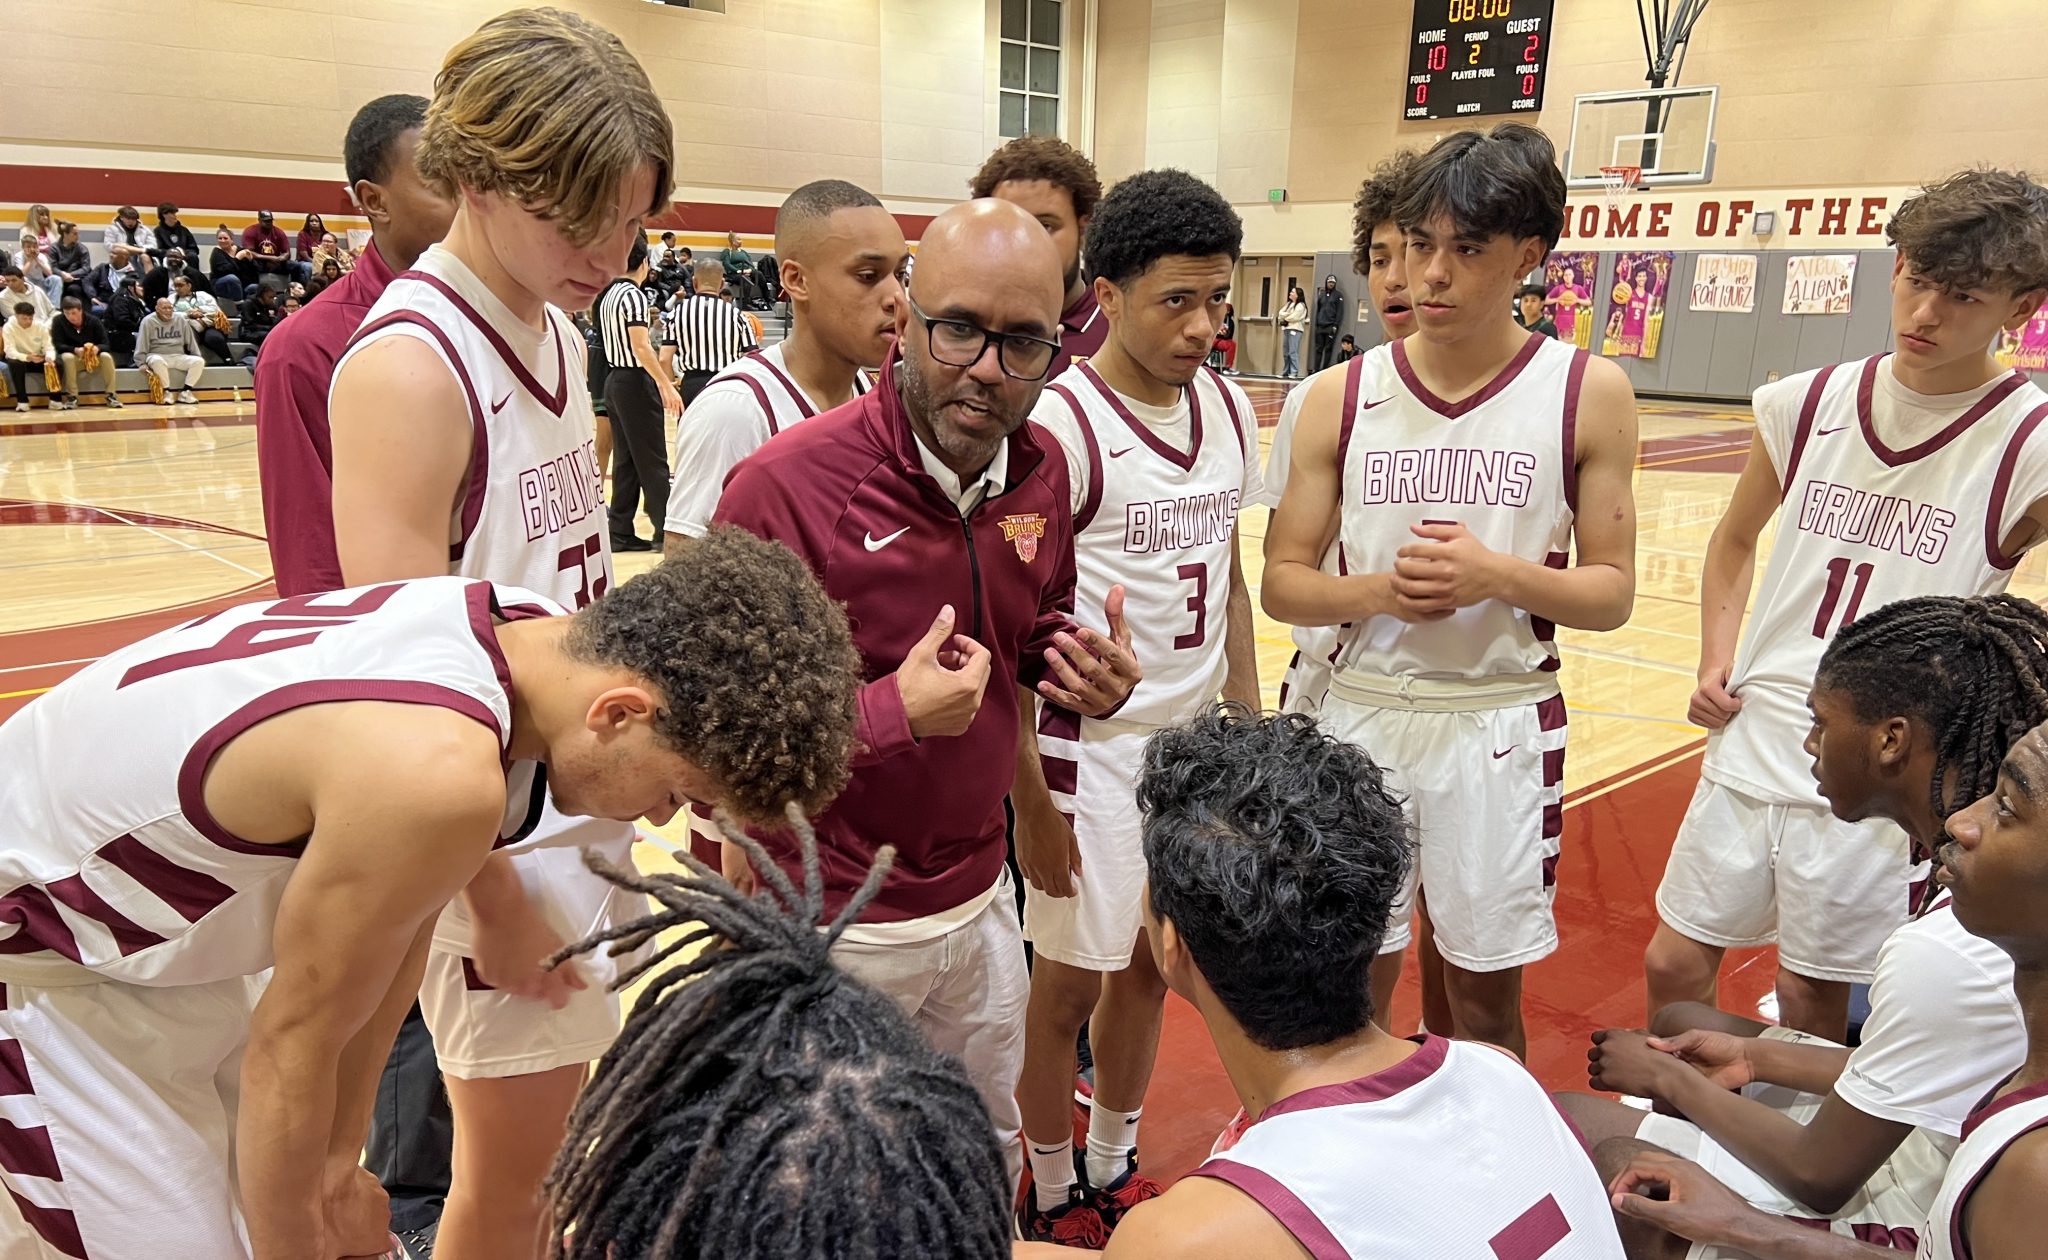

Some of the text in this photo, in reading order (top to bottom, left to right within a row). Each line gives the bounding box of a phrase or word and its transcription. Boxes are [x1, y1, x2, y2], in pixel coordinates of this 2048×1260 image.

[1418, 29, 1447, 44] HOME
[1506, 17, 1541, 35] GUEST
[1464, 31, 1489, 43] PERIOD
[1427, 45, 1448, 71] 10
[1468, 43, 1481, 65] 2
[1523, 35, 1539, 62] 2
[1410, 74, 1431, 85] FOULS
[1451, 68, 1496, 81] PLAYER FOUL
[1515, 63, 1539, 75] FOULS
[1415, 84, 1428, 105] 0
[1522, 74, 1535, 96] 0
[1406, 107, 1428, 117] SCORE
[1456, 103, 1481, 114] MATCH
[1511, 98, 1536, 110] SCORE
[1695, 200, 1755, 238] OF
[1785, 197, 1888, 236] THE
[1363, 448, 1536, 508] BRUINS
[1006, 522, 1042, 537] BRUINS
[1123, 488, 1240, 554] BRUINS
[1798, 480, 1957, 565] BRUINS
[1173, 562, 1208, 651] 3
[1811, 557, 1875, 640] 11
